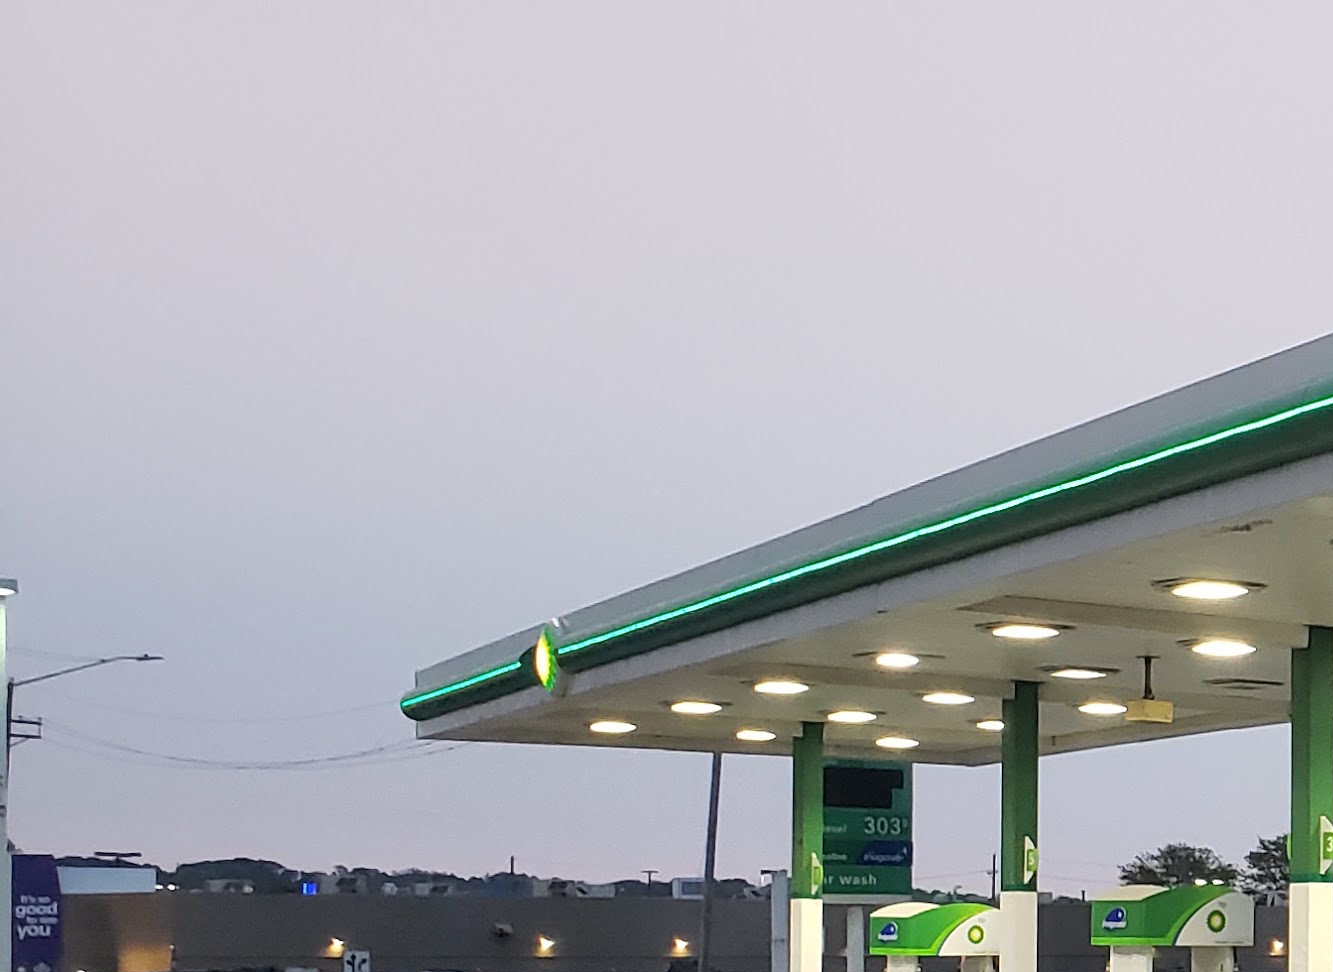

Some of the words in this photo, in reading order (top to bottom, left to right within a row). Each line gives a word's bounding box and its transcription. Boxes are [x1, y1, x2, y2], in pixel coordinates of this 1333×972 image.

[1028, 852, 1035, 866] 5
[840, 874, 877, 885] wash
[15, 901, 58, 919] good
[17, 924, 51, 941] you
